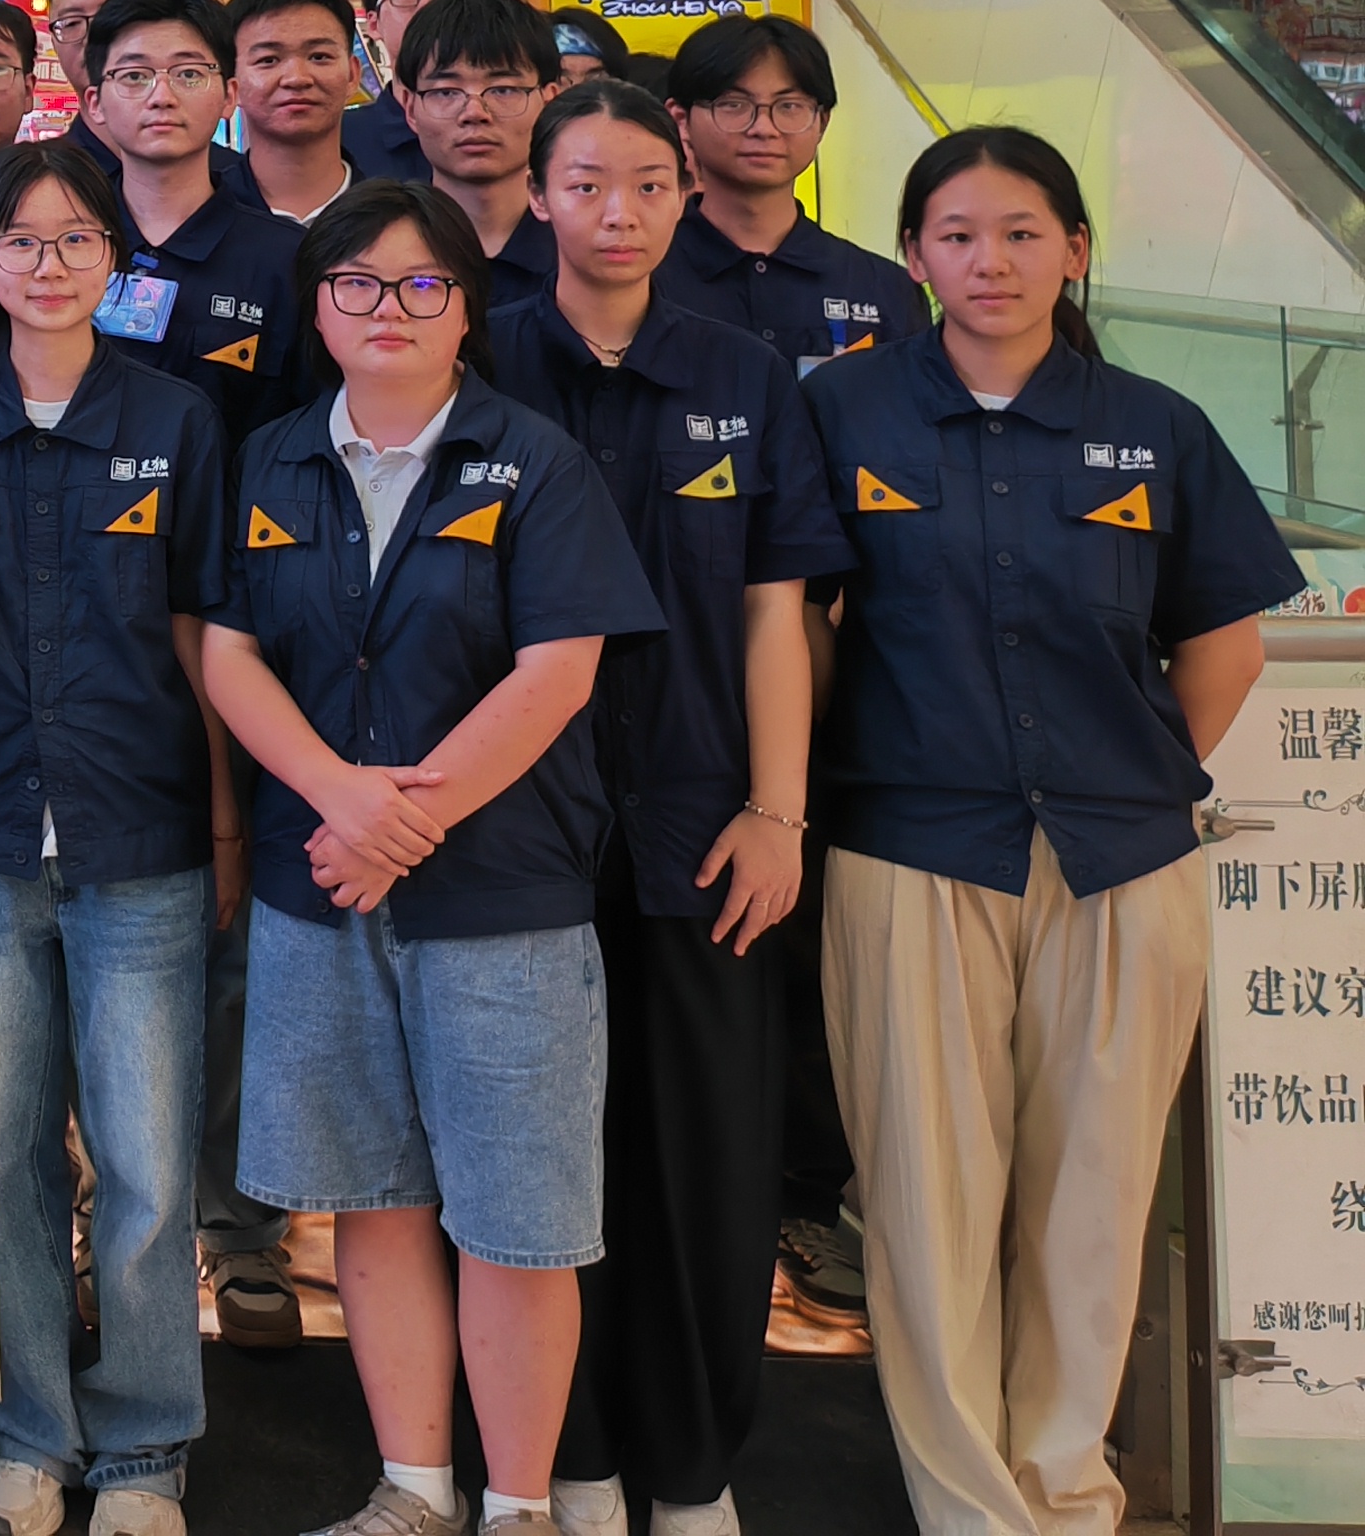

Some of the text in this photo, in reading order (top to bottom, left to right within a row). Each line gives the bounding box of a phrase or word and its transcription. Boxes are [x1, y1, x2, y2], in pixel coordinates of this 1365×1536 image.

[602, 1, 666, 16] ZHOU
[670, 1, 705, 14] HEI
[1278, 707, 1363, 761] 温馨
[1245, 965, 1365, 1018] 建议穿
[1227, 1072, 1365, 1126] 带饮品
